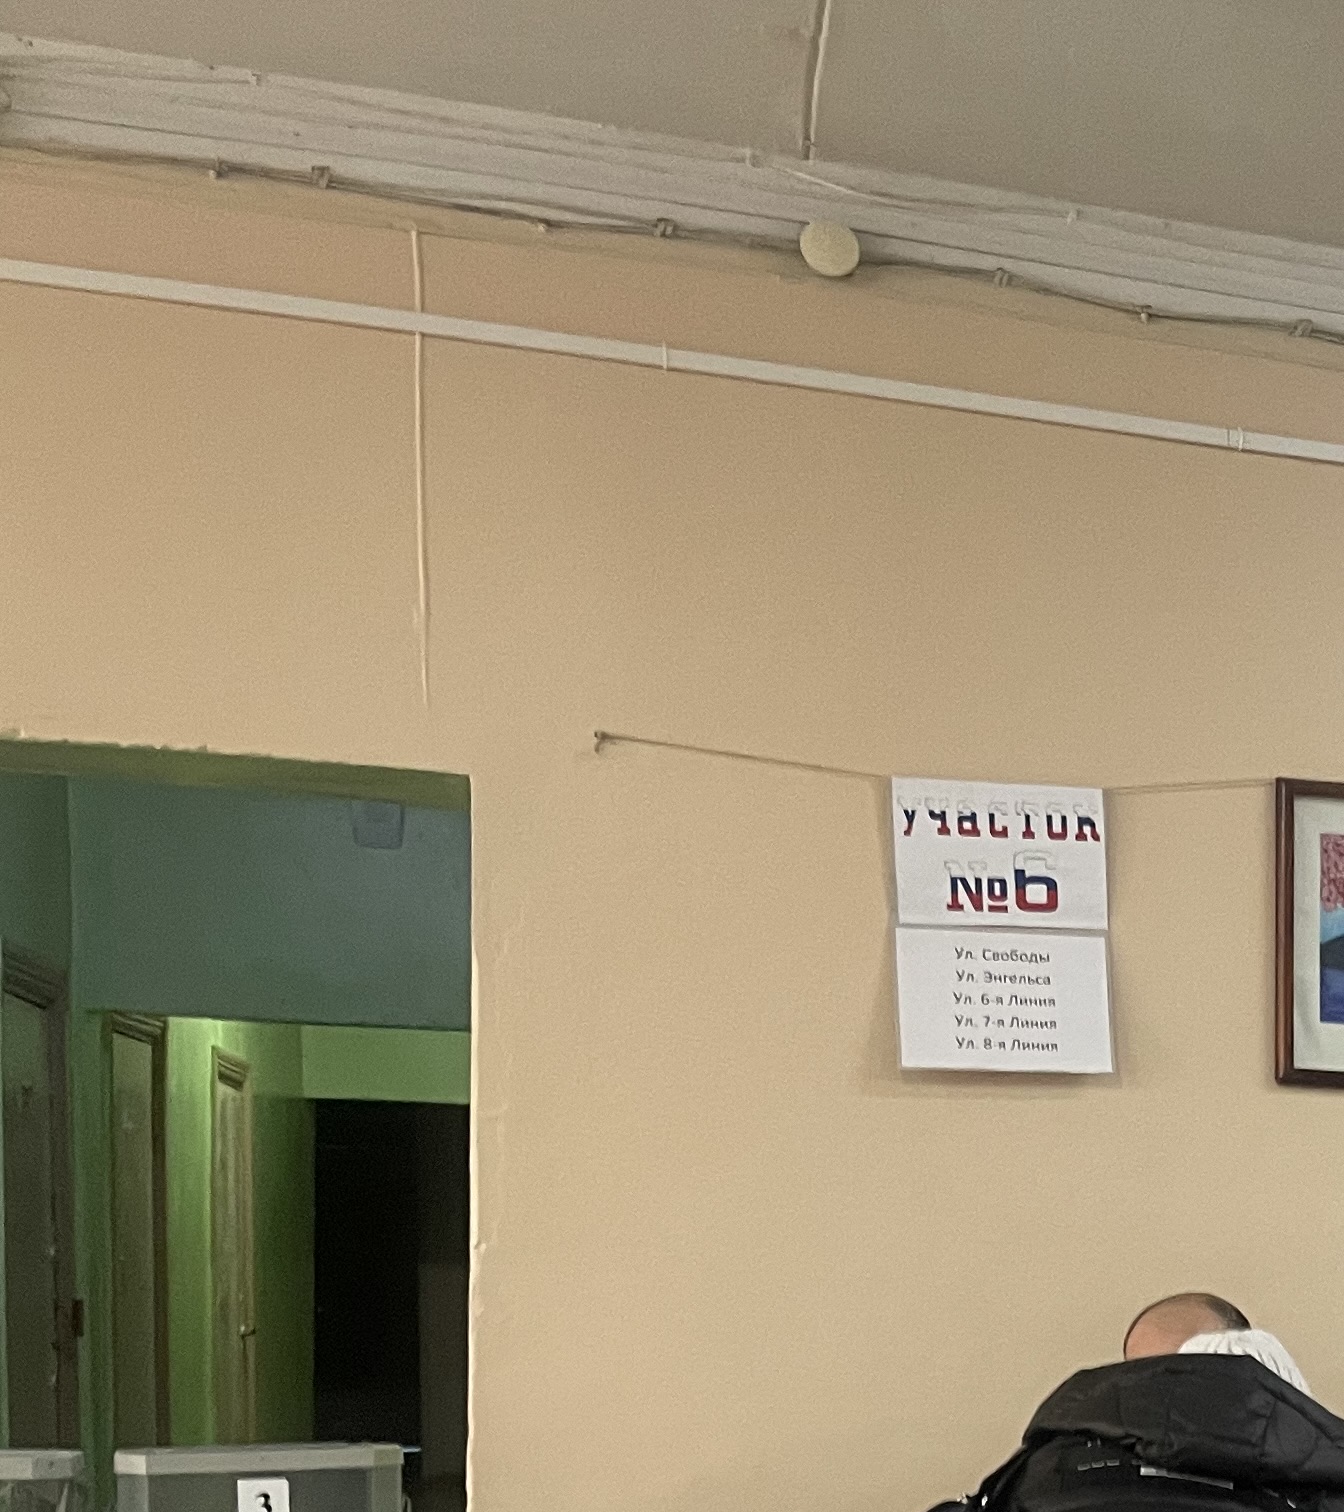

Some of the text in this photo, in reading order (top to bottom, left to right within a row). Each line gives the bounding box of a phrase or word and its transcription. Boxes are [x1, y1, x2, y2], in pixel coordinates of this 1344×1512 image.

[954, 946, 1051, 964] Ул. Свободы
[955, 969, 1051, 986] Ул. Энгельса
[952, 991, 1056, 1008] Ул. 6-я Линия
[954, 1014, 1058, 1030] Ул. 7-я Линия
[955, 1036, 1059, 1053] Ул. 8-я Линия
